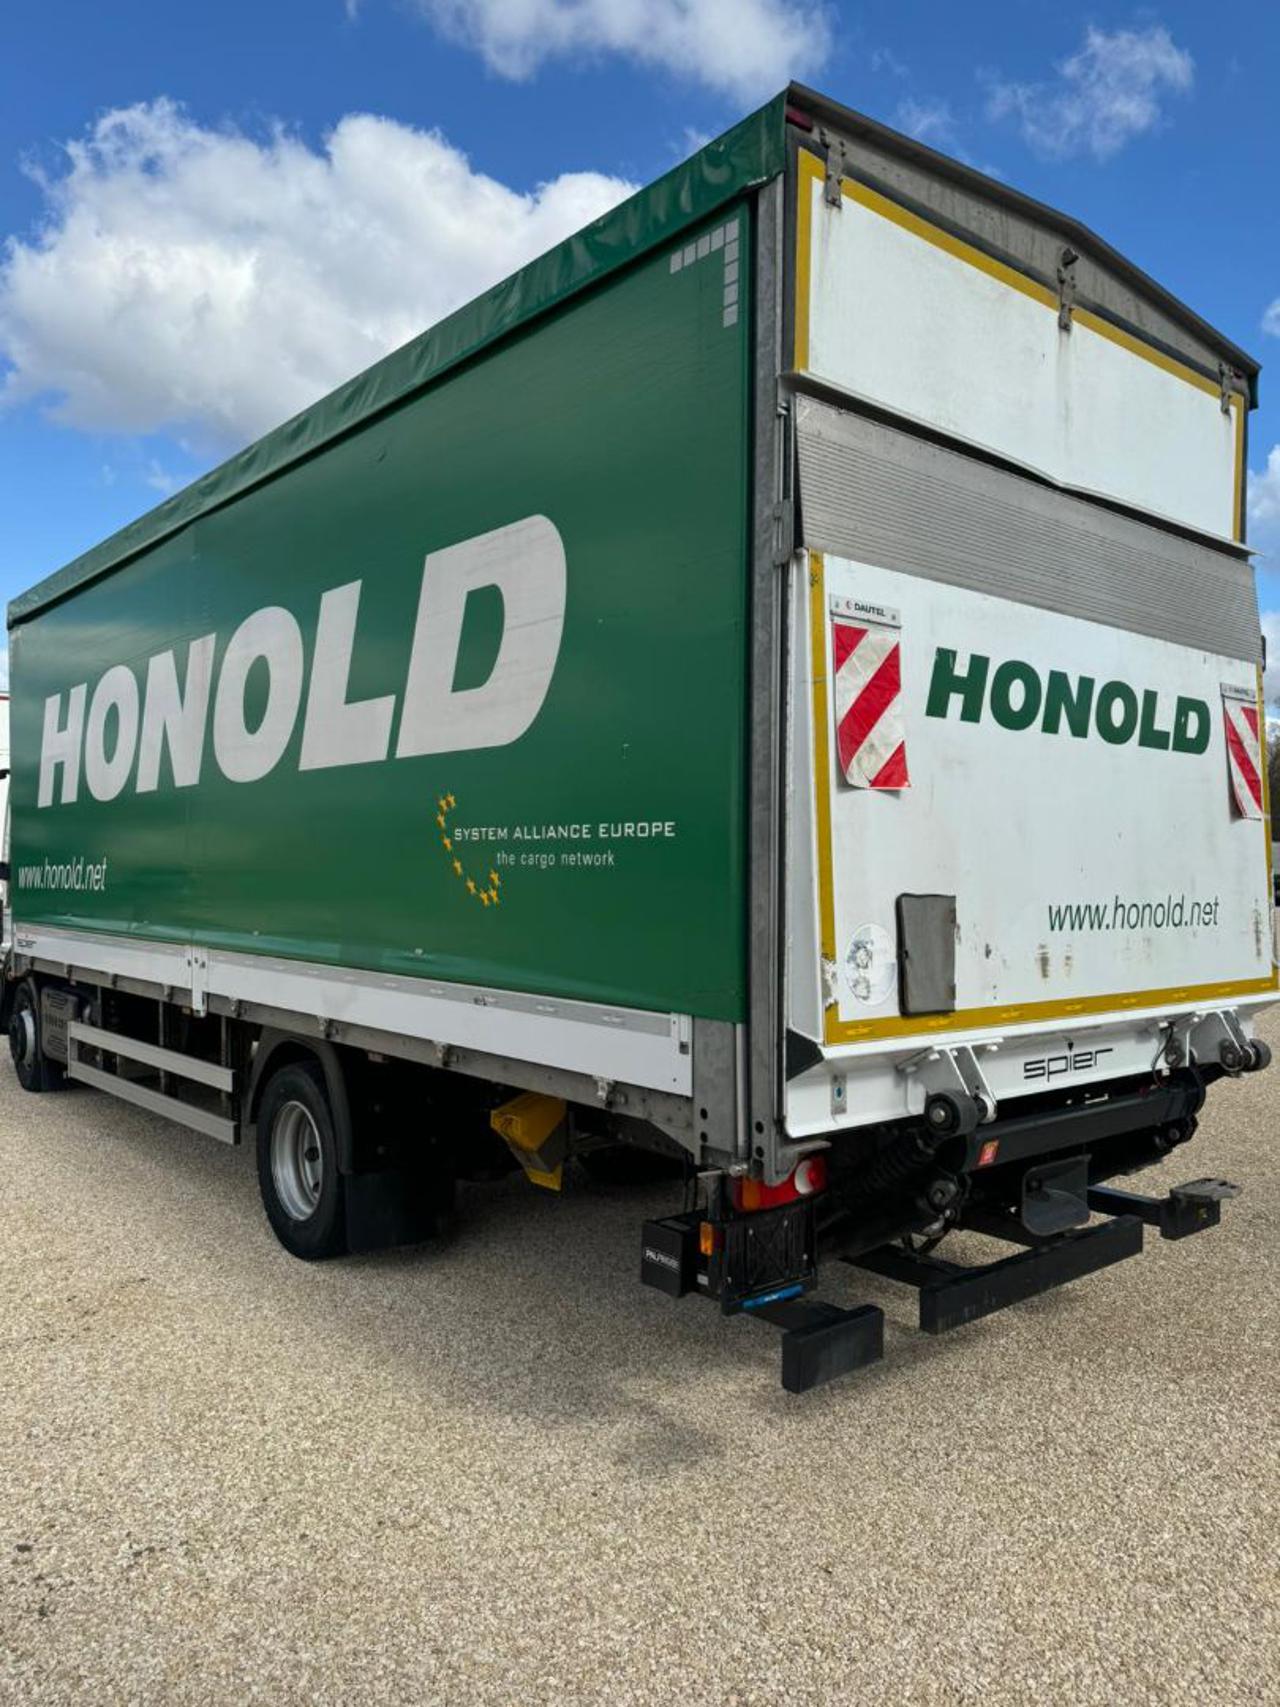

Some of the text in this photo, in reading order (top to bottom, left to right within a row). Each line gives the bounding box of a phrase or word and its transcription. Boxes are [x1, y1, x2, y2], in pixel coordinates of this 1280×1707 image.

[854, 602, 886, 617] DAUTEL
[37, 514, 567, 807] HONOLD
[925, 647, 1211, 755] HONOLD
[454, 821, 676, 841] SYSTEM ALLIANCE EUROPE
[18, 856, 107, 891] www.honold.net
[497, 850, 615, 869] the cargo network
[1048, 895, 1219, 932] www.honold.net
[1023, 1041, 1113, 1082] spier
